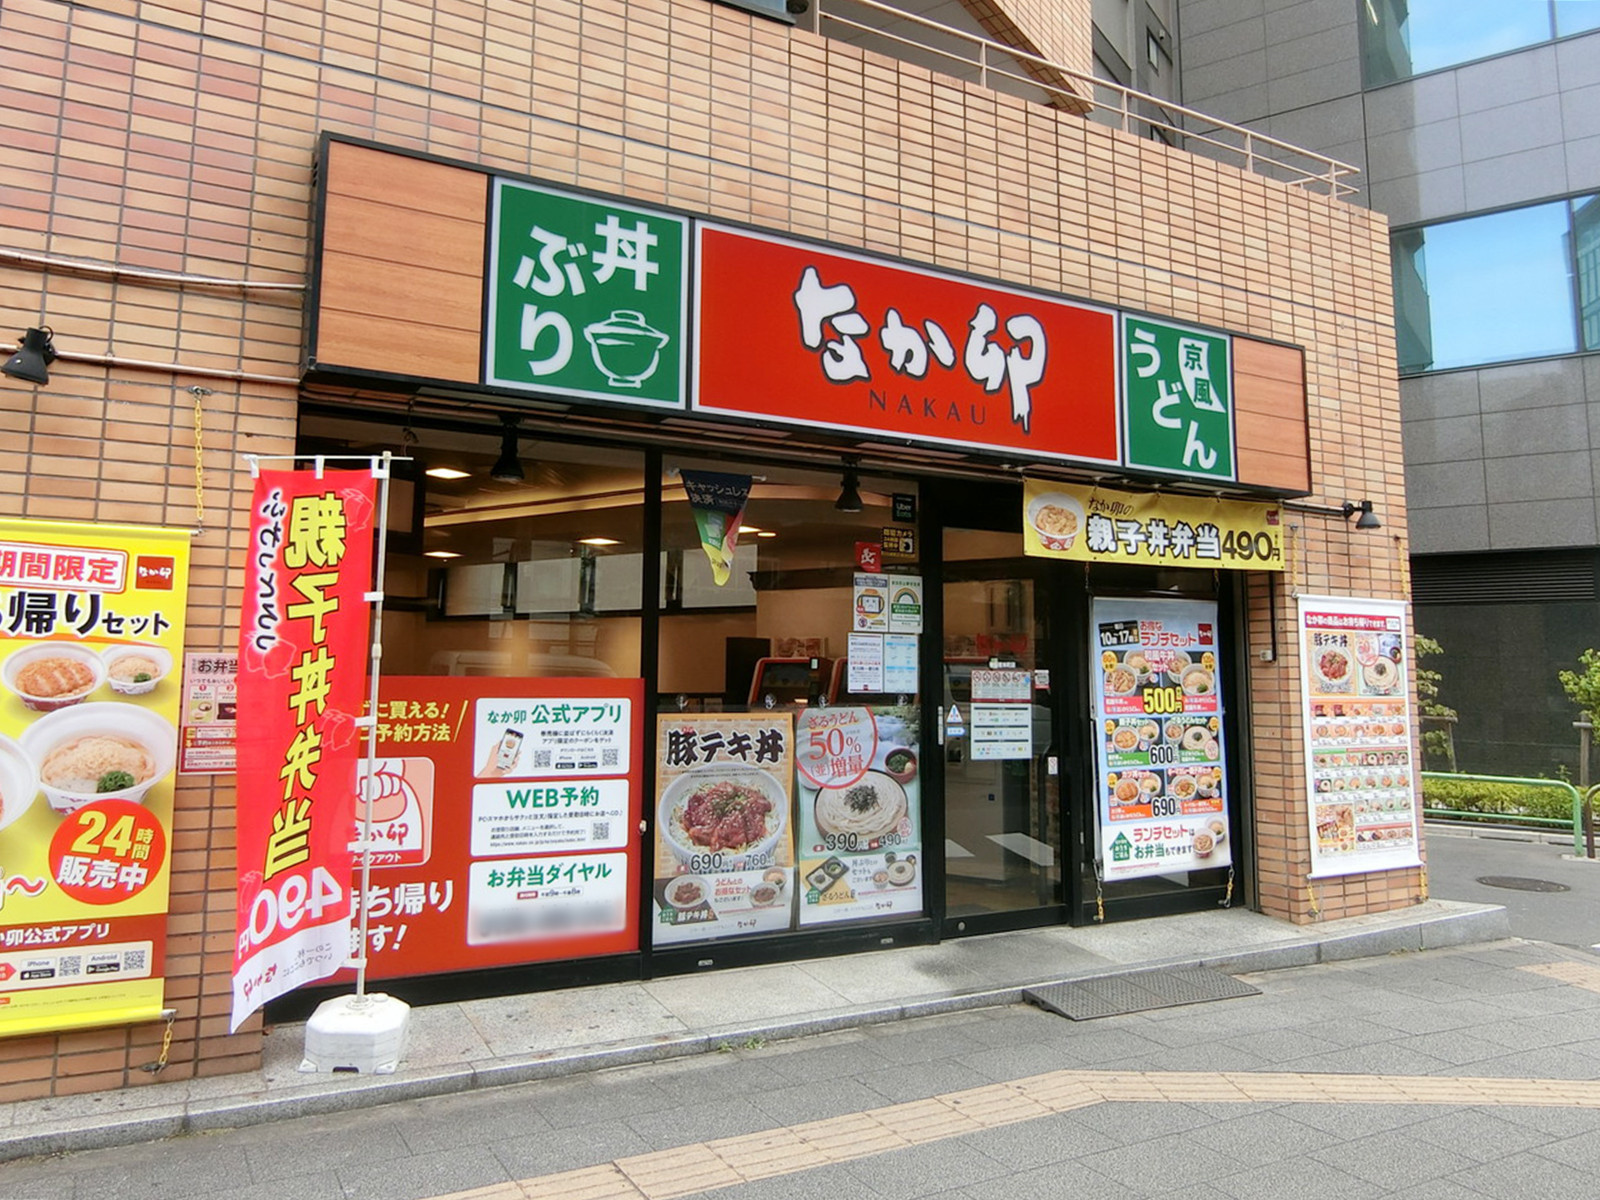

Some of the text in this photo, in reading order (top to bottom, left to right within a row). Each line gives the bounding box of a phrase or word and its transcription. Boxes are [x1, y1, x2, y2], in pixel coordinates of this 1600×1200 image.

[792, 264, 1048, 435] なか卯
[1183, 342, 1214, 407] 京風
[869, 388, 988, 426] NAKAU
[1130, 327, 1218, 470] うどん
[686, 480, 748, 497] キャッシュレス
[1088, 497, 1134, 516] なか卯の
[1087, 513, 1221, 560] 親子丼弁当
[0, 590, 169, 636] 帰りセット
[1140, 632, 1197, 647] ランチセット
[486, 703, 622, 725] なか卯 公式アプリ
[808, 711, 859, 729] ざるうどん
[666, 728, 784, 766] 豚テキ丼
[809, 727, 862, 760] 50%
[506, 786, 600, 809] WEB予約
[1133, 825, 1195, 843] ランチセットは
[56, 855, 148, 892] 販売中
[487, 862, 612, 889] お弁当ダイヤル
[0, 923, 110, 947] 卯公式アプリ
